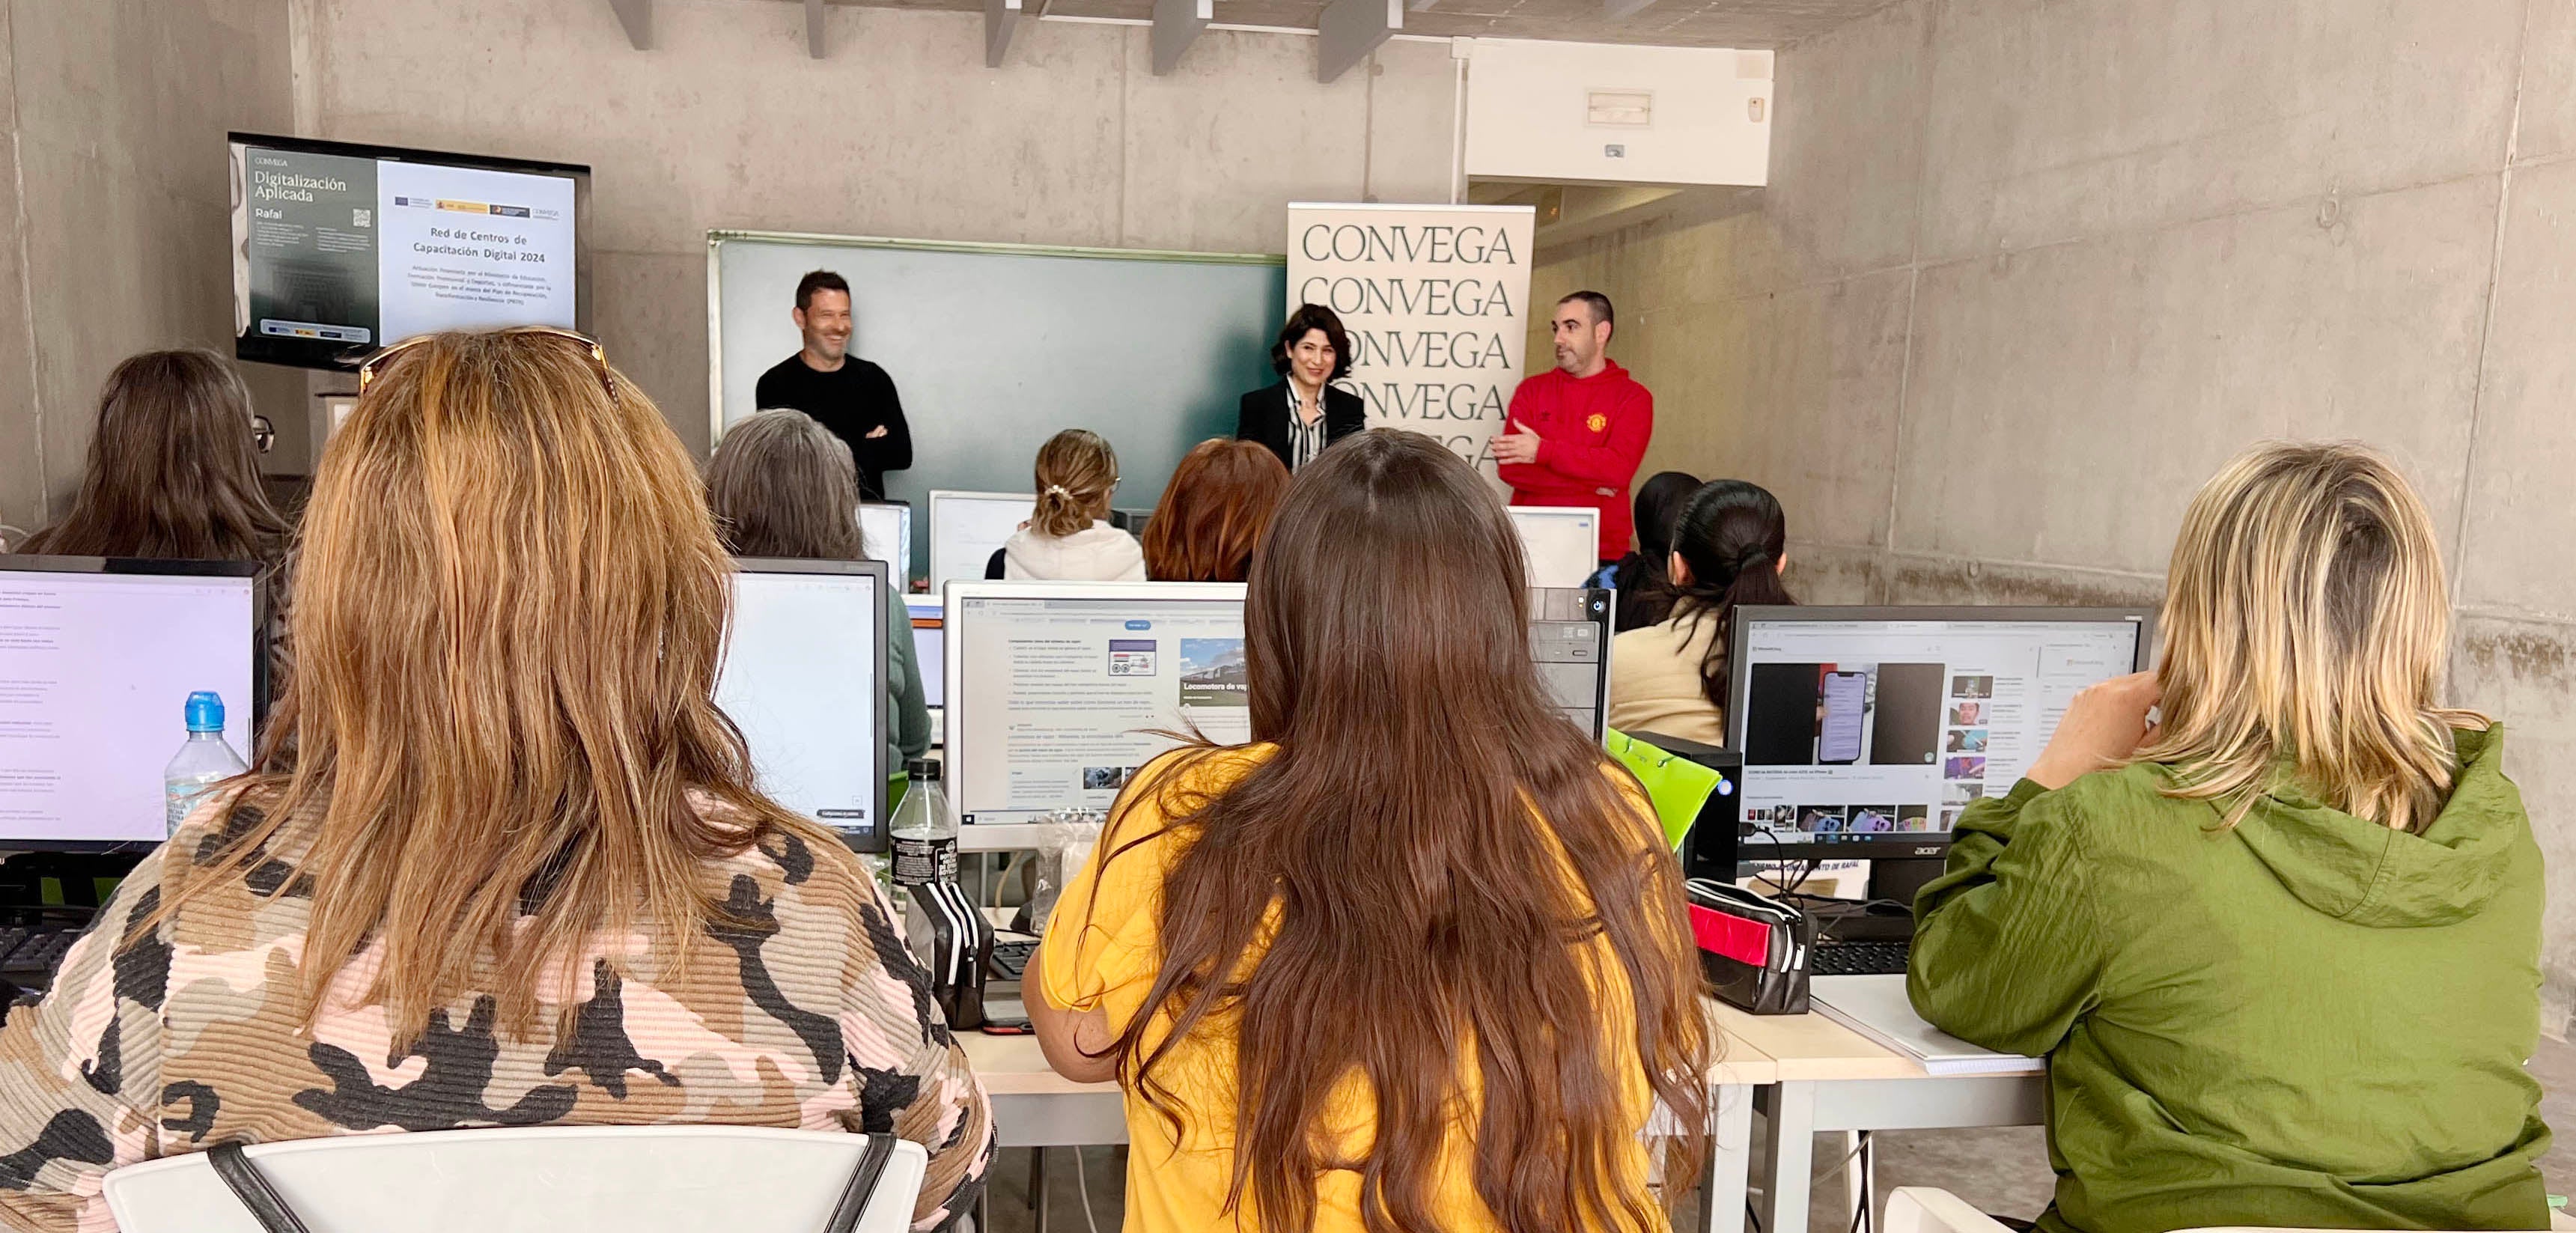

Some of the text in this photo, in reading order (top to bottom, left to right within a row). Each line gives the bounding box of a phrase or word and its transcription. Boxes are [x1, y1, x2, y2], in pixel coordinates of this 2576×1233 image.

[255, 171, 347, 192] Digitalización
[255, 186, 314, 202] Aplicada
[255, 207, 282, 219] Rafal
[430, 227, 527, 246] Red de Centros de
[1303, 224, 1517, 264] CONVEGA
[413, 242, 546, 263] Capacitación Digital 2024
[1301, 276, 1514, 317] CONVEGA
[1345, 329, 1511, 369] ONVEGA
[1914, 847, 1941, 855] acer
